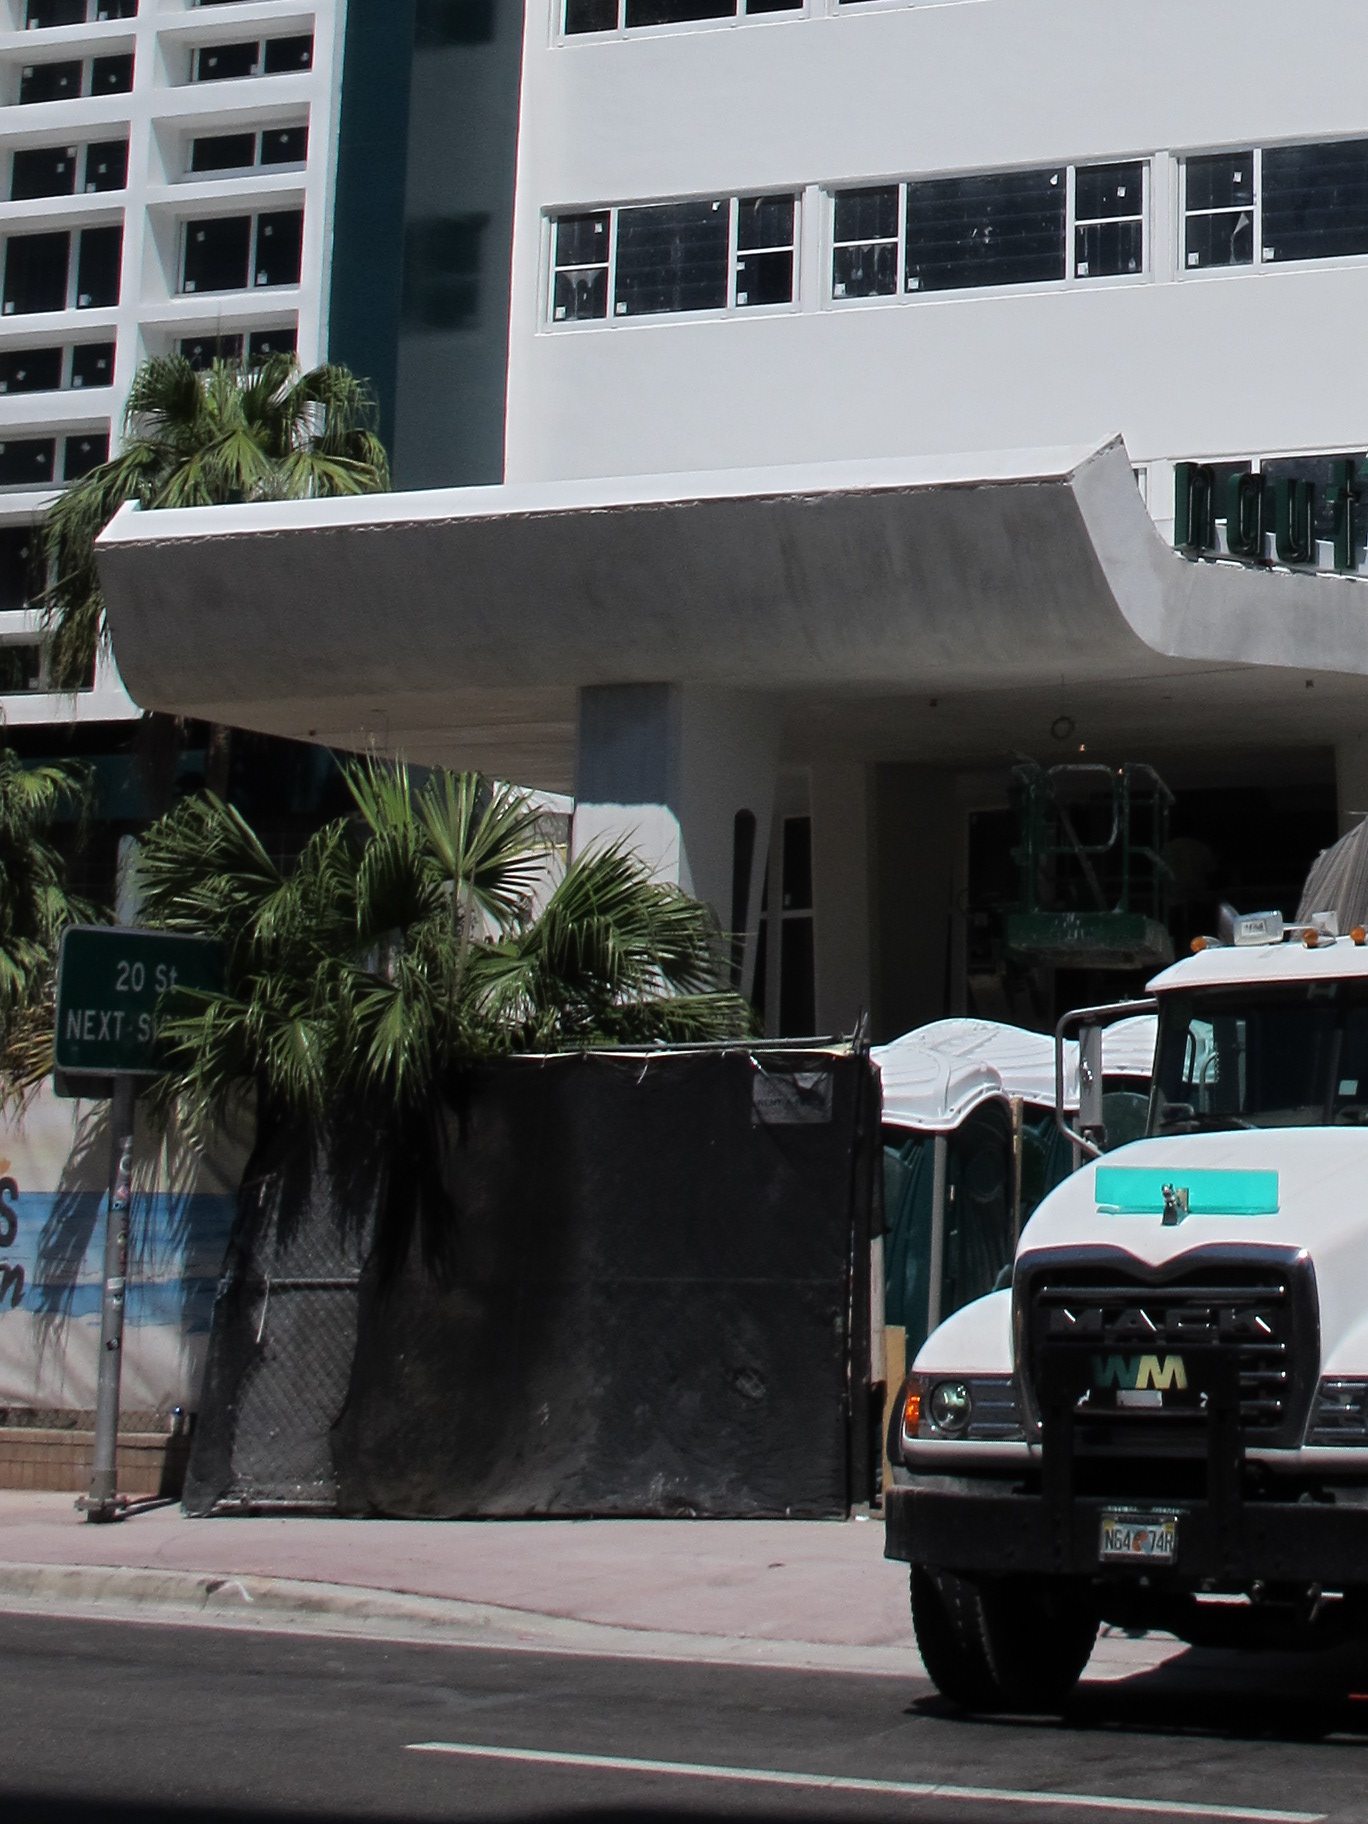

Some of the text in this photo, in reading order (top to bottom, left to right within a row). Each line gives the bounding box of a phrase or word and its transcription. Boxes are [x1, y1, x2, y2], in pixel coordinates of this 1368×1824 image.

[115, 960, 178, 995] 20 St
[66, 1009, 125, 1041] NEXT
[1090, 1354, 1188, 1390] WM
